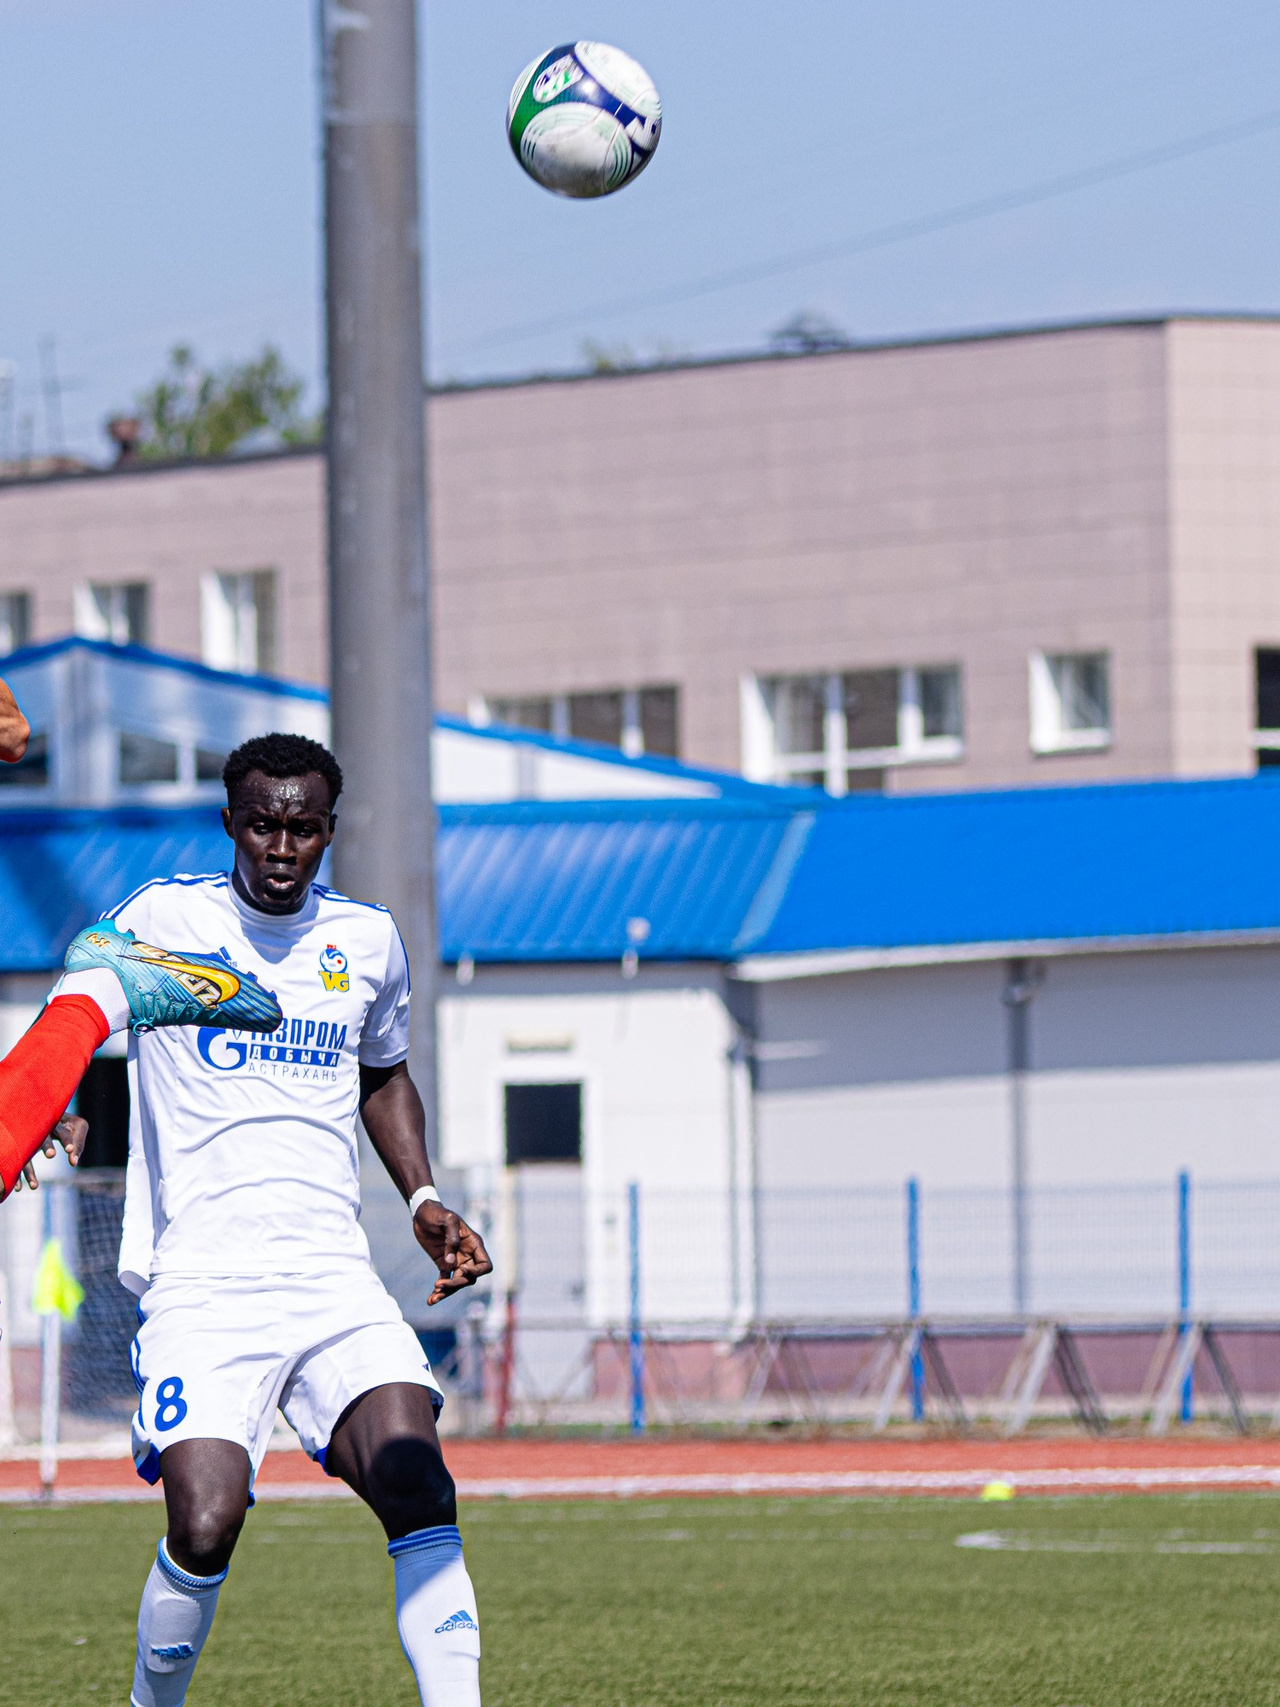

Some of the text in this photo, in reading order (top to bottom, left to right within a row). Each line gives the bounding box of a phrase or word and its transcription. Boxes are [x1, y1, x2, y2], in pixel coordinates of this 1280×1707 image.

[251, 1044, 338, 1066] ДОБЫЧА
[248, 1062, 338, 1082] АСТРАХАНЬ
[154, 1375, 188, 1432] 8
